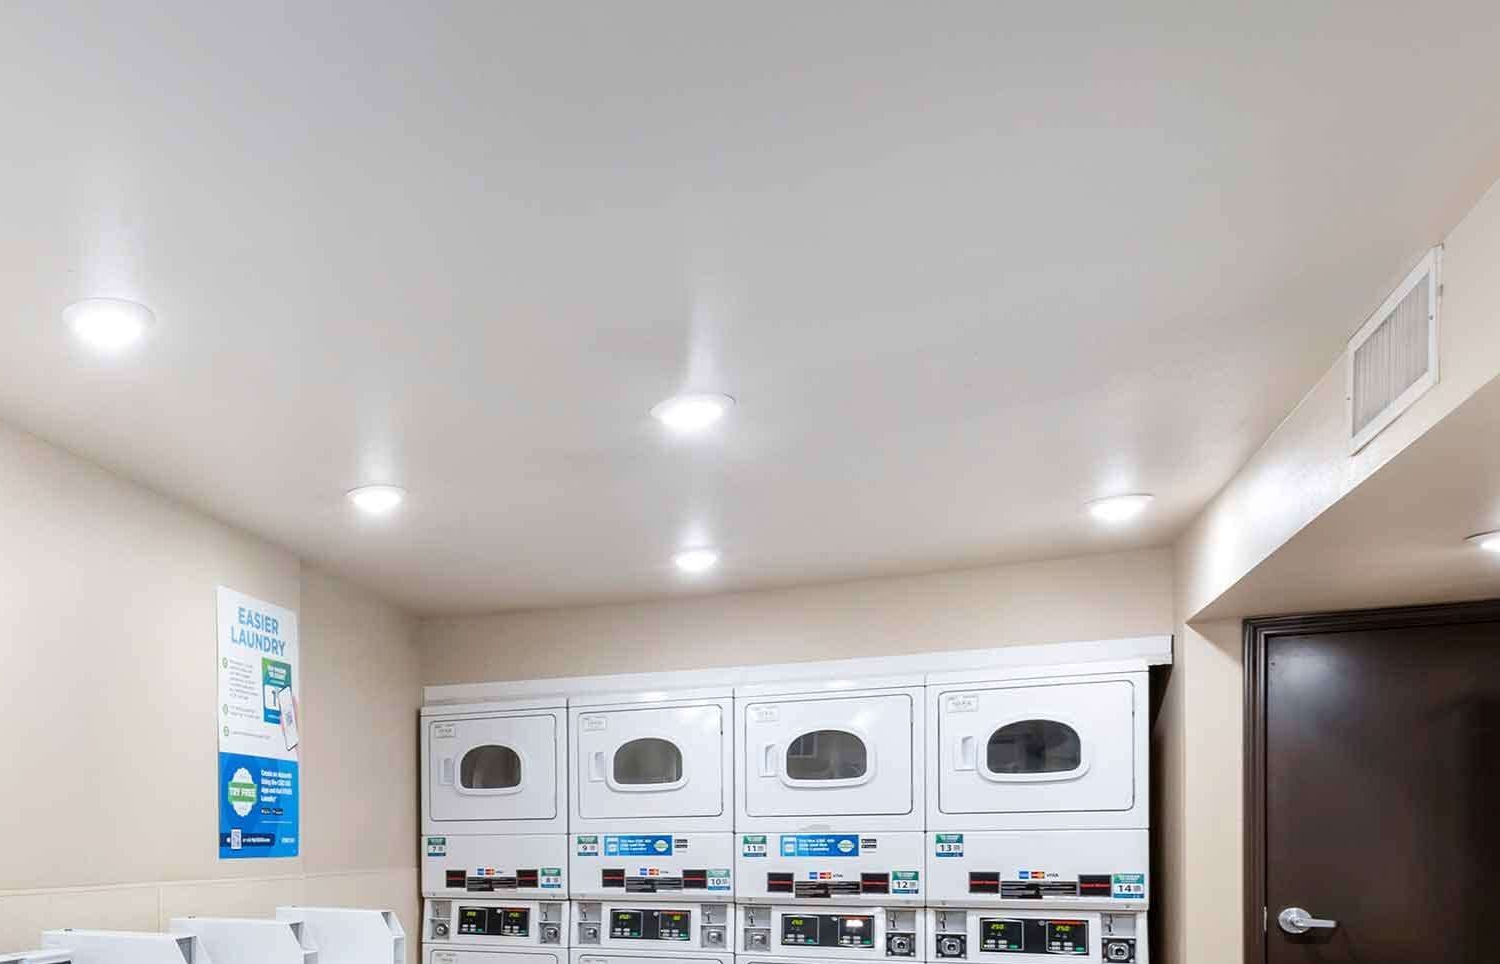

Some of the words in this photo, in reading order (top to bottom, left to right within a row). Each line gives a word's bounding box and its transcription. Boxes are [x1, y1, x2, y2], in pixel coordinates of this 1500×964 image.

[238, 607, 278, 635] EASIER
[231, 624, 285, 656] LAUNDRY
[940, 844, 952, 852] 13
[1118, 885, 1131, 893] 14
